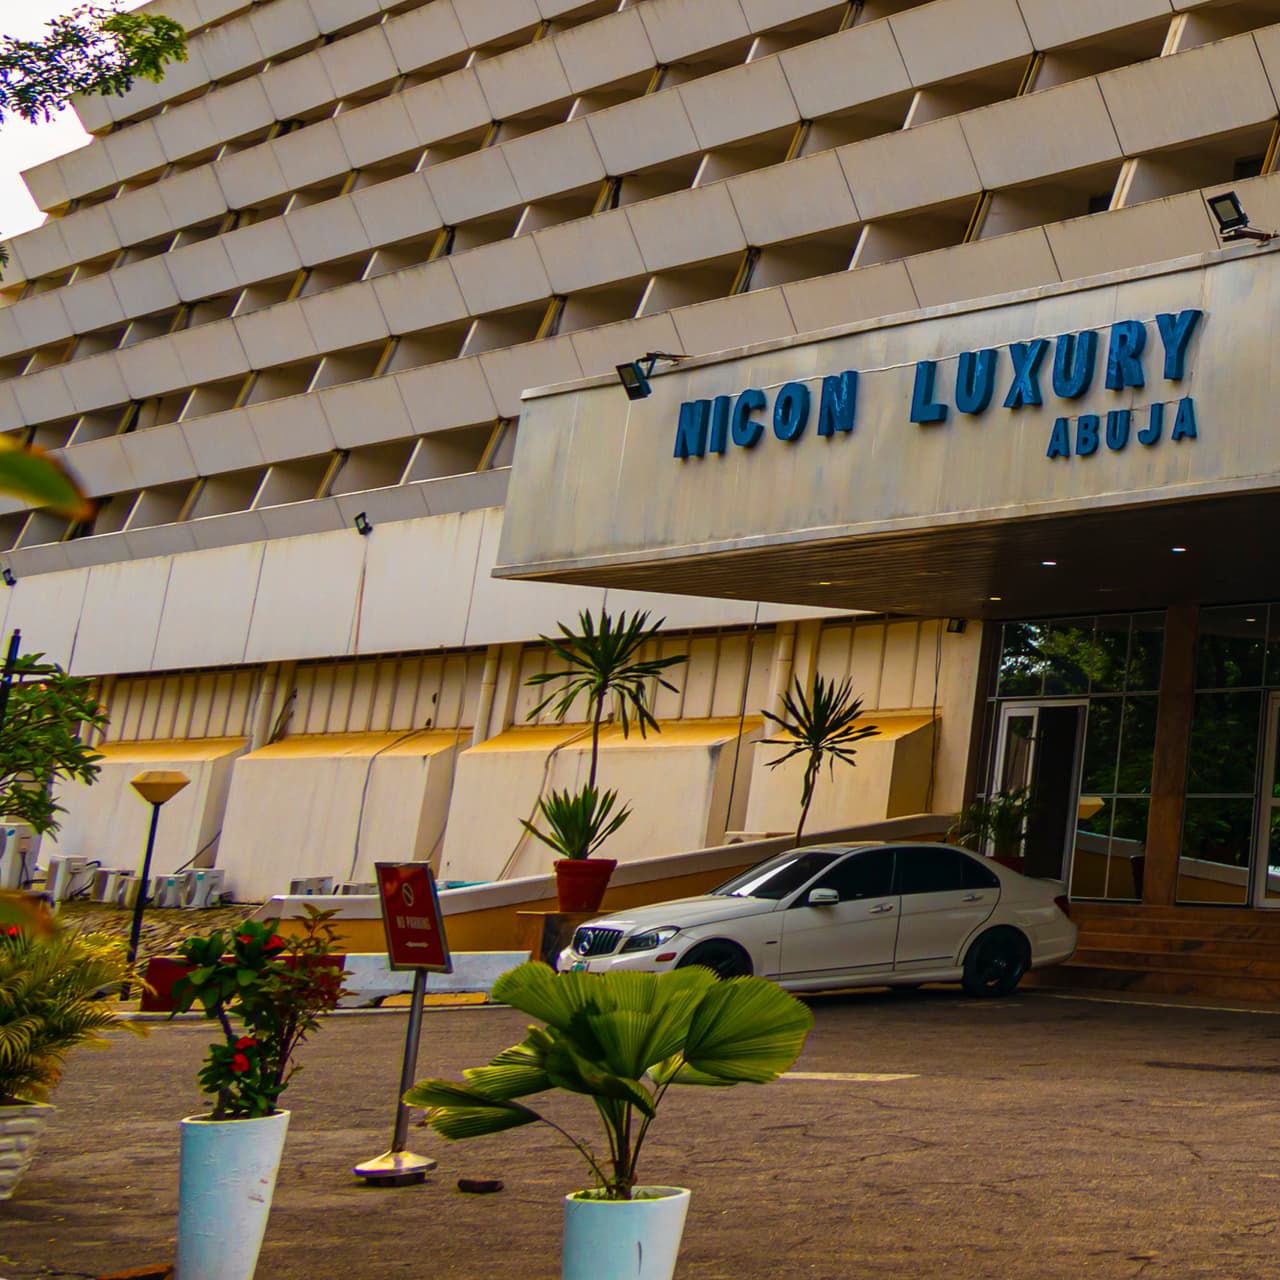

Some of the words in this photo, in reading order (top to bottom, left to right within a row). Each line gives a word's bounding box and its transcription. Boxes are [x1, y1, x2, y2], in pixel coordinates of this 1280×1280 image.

[673, 370, 859, 458] NICON
[909, 309, 1203, 423] LUXURY
[1046, 397, 1198, 458] ABUJA
